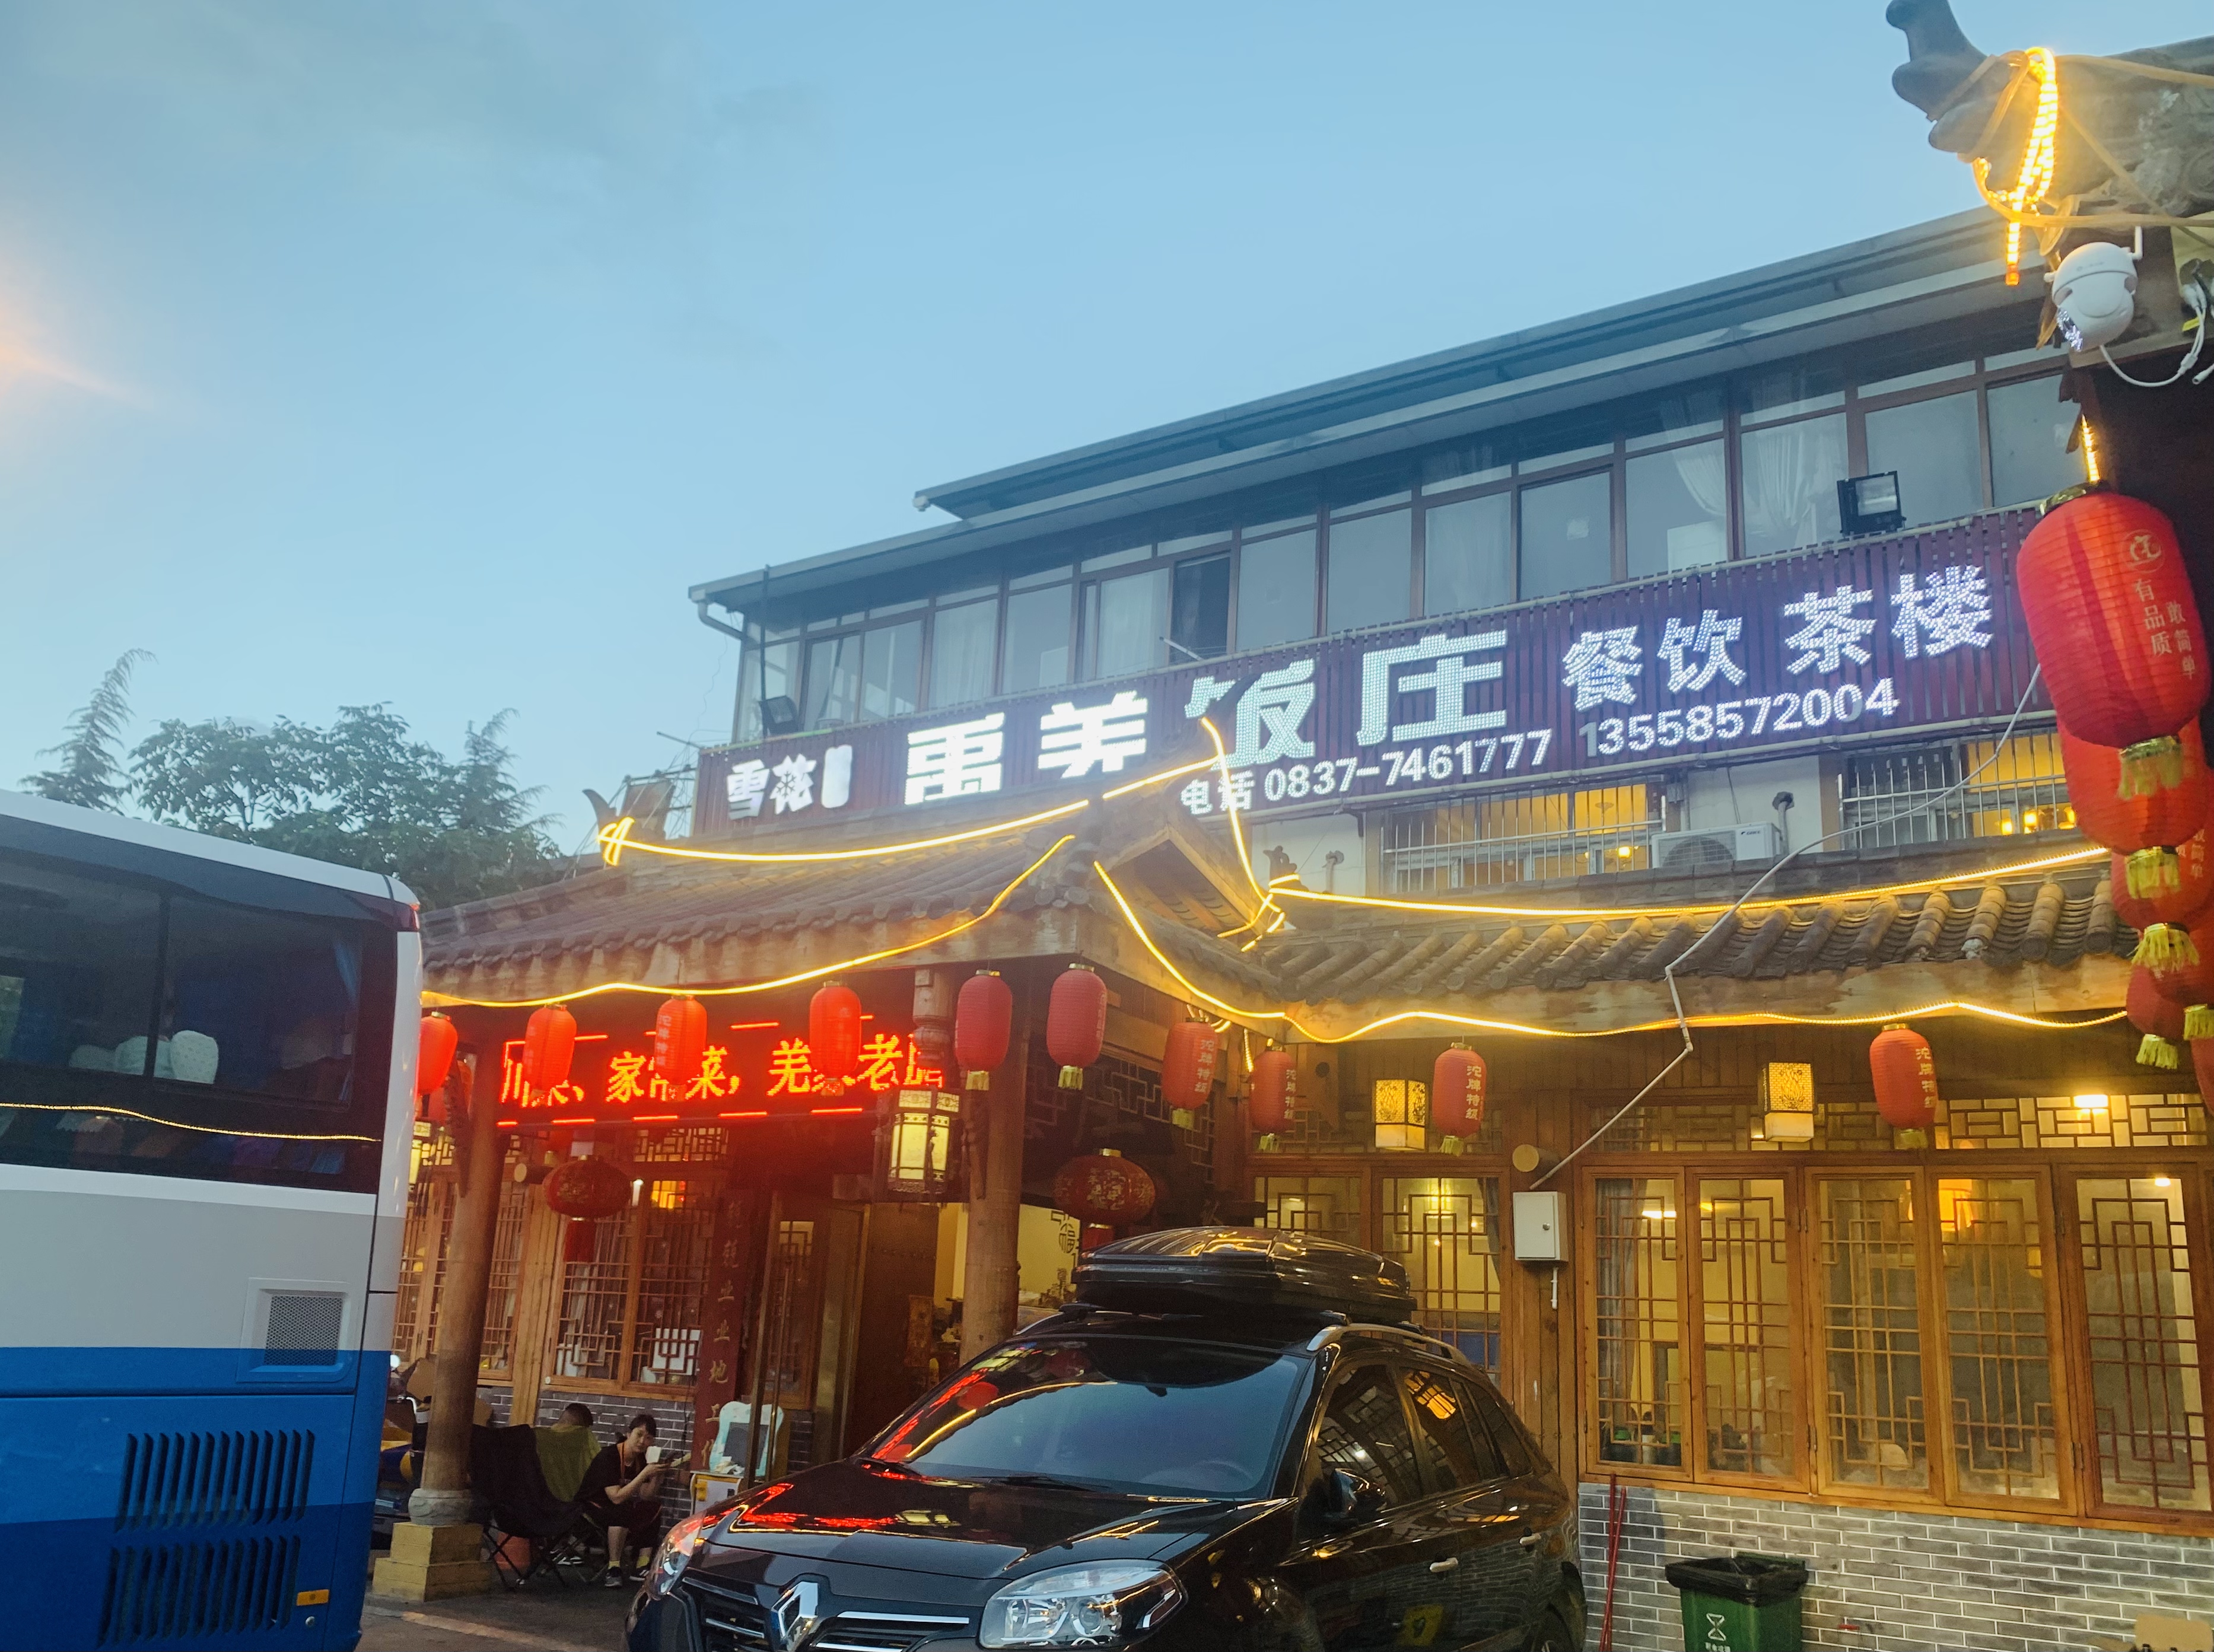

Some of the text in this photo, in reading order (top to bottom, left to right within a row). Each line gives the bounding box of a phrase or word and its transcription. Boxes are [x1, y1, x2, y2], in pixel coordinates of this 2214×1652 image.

[1562, 565, 1994, 712] 餐饮 茶楼
[2134, 578, 2172, 656] 有品质
[1180, 677, 1901, 814] 电话 0837-7461777 13558572004
[726, 753, 817, 820] 雪花
[1465, 1065, 1483, 1121] 沱牌特级
